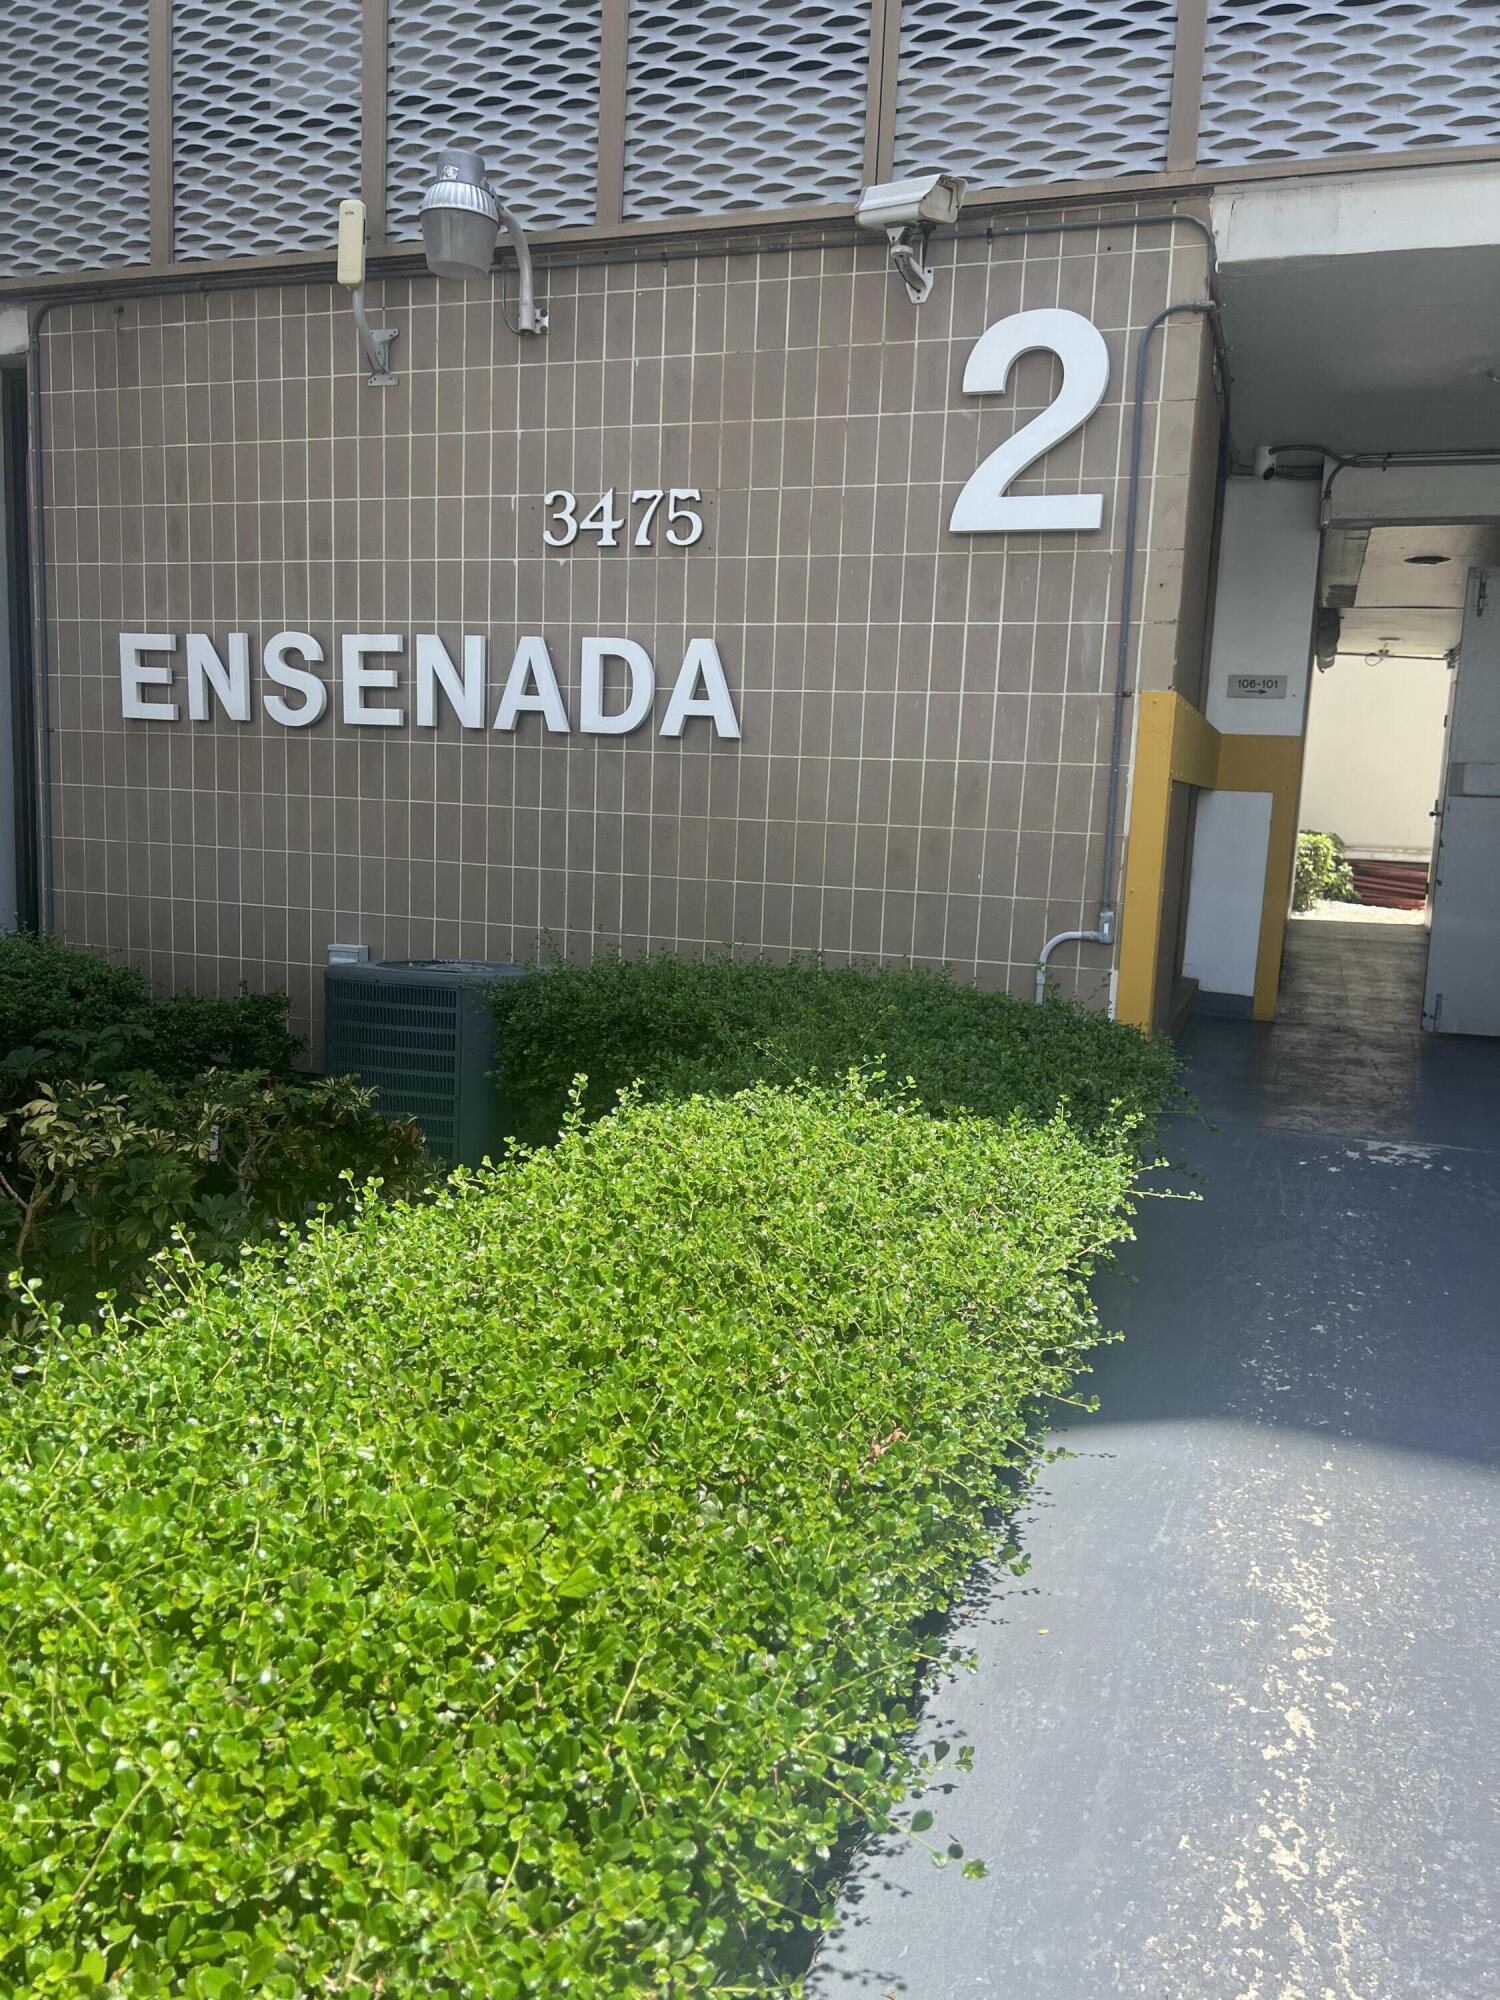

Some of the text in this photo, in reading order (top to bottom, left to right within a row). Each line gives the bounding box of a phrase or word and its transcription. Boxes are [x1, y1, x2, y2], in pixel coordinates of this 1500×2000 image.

[949, 308, 1110, 534] 2
[542, 487, 703, 547] 3475
[118, 631, 742, 739] ENSENADA
[1237, 679, 1279, 689] 106-101
